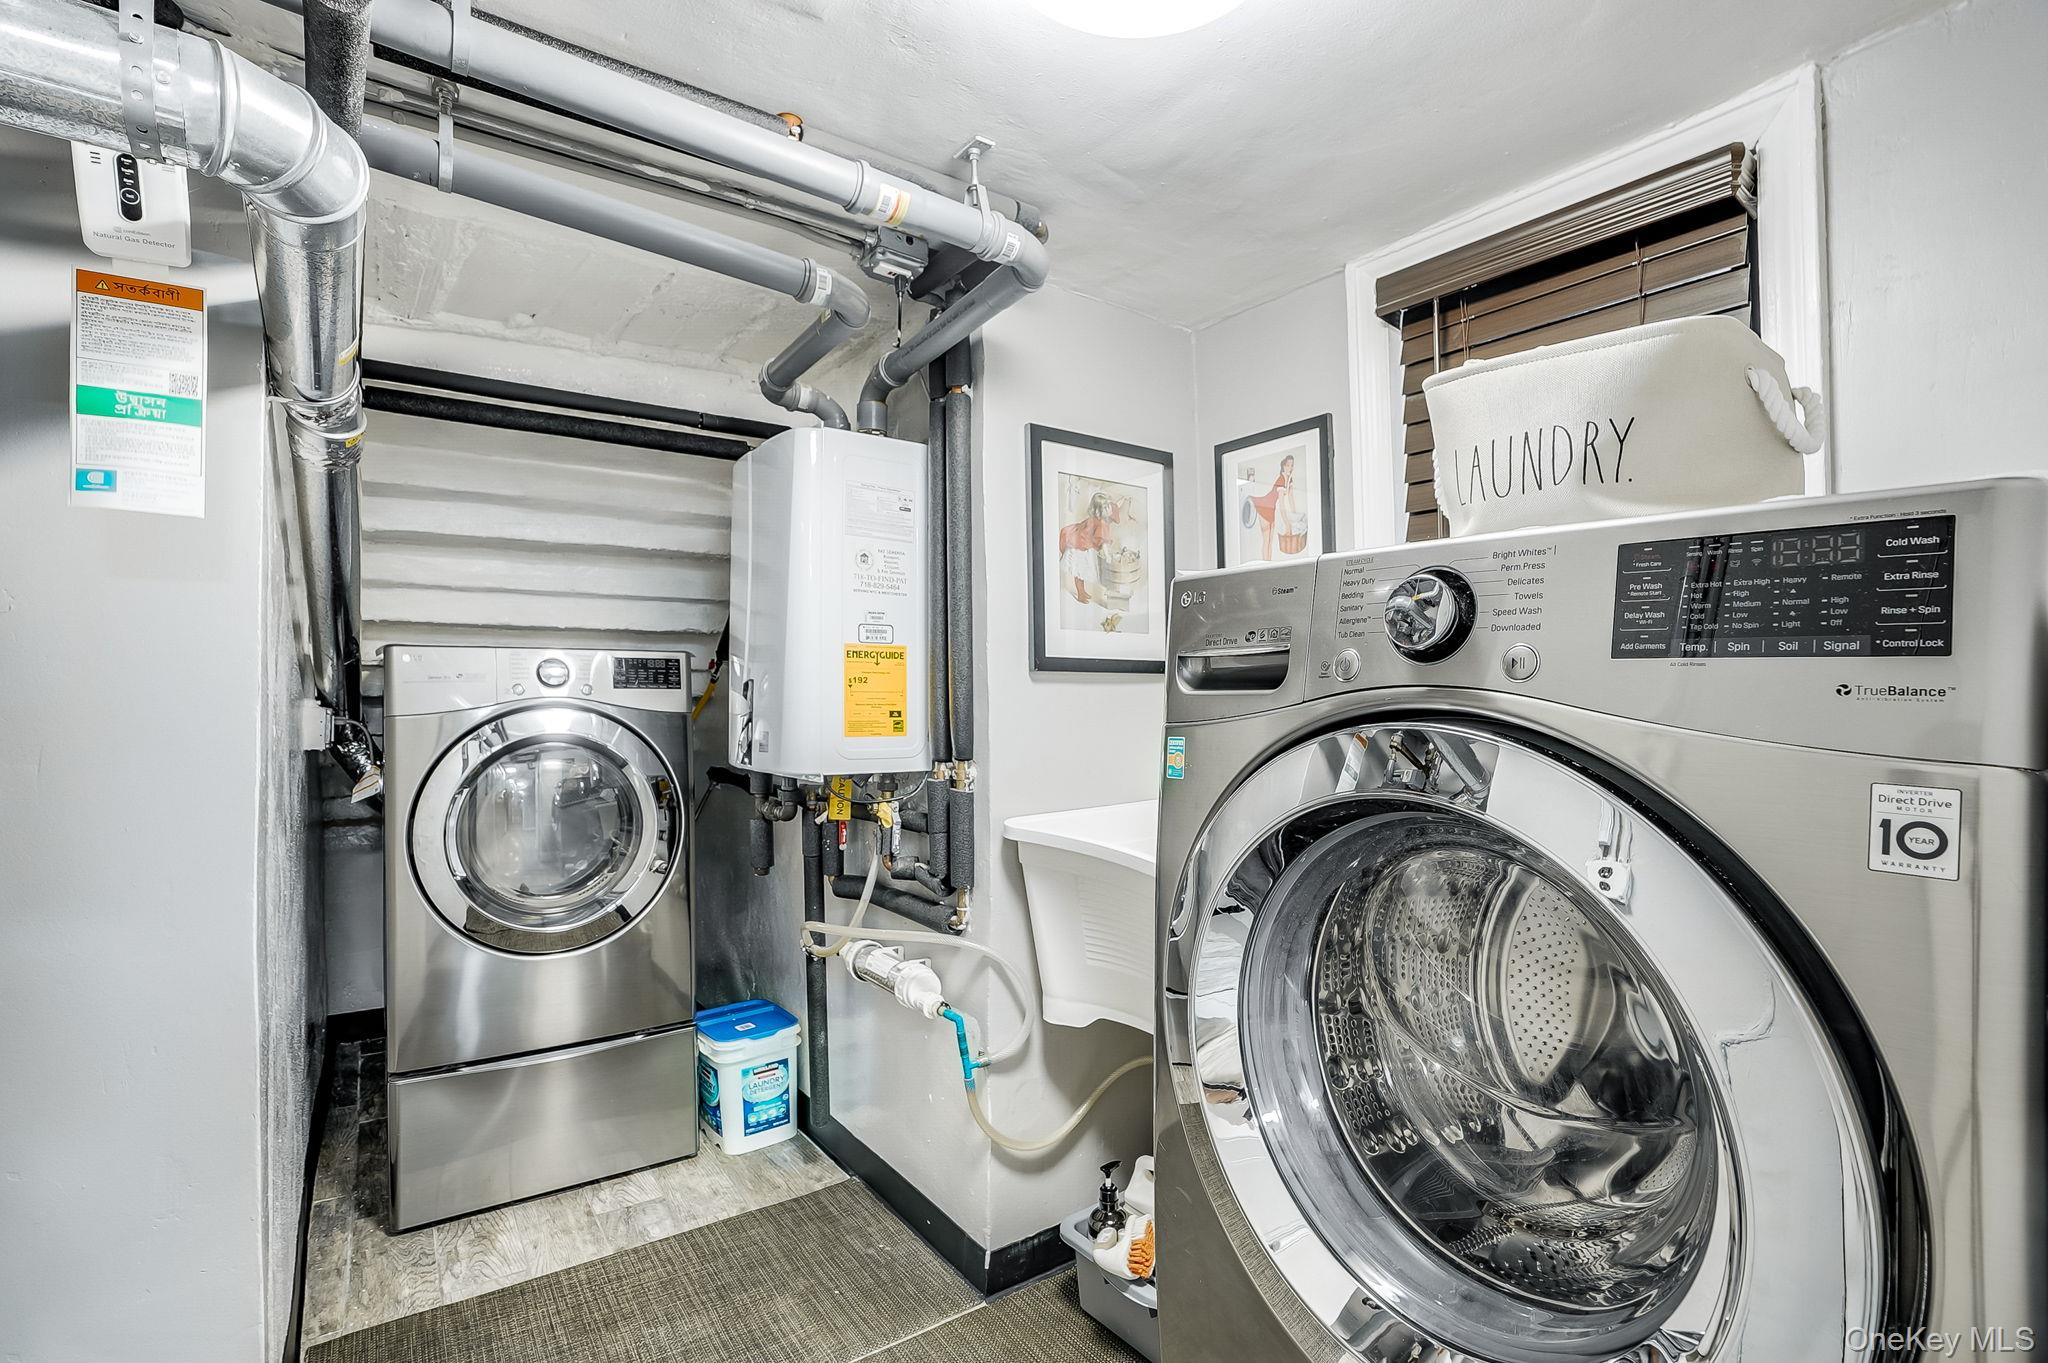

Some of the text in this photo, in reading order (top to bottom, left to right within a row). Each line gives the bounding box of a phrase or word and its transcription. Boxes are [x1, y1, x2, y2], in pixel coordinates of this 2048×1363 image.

[92, 231, 175, 249] Natural Gas Detector
[112, 281, 181, 301] সতর্কবাণী
[1885, 535, 1940, 547] Cold Wash
[1492, 550, 1517, 560] Bright
[1344, 566, 1365, 576] Normal
[1523, 562, 1546, 570] Press
[1782, 576, 1808, 584] Heavy
[1831, 573, 1862, 581] Remote
[1884, 571, 1940, 581] Extra Rinse
[1343, 577, 1376, 587] Heavy Duty
[1507, 577, 1545, 586] Delicates
[1642, 582, 1663, 590] Wash
[1341, 592, 1365, 600] Bedding
[1514, 592, 1544, 601] Towels
[1733, 590, 1750, 598] High
[1782, 598, 1810, 606] Normal
[1830, 596, 1850, 604] High
[1340, 605, 1364, 613] Sanitary
[1492, 606, 1543, 618] Speed Wash
[1881, 606, 1908, 615] Rinse
[1918, 605, 1941, 615] Spin
[1624, 611, 1665, 620] Delay Wash
[1490, 622, 1542, 632] Downloaded
[1743, 622, 1760, 630] Spin
[1781, 621, 1801, 629] Light
[1338, 631, 1349, 639] Tub
[1205, 637, 1238, 647] Direct Drive
[1778, 641, 1799, 651] Soil
[1823, 640, 1860, 652] Signal
[1882, 639, 1944, 647] Control Lock
[1680, 642, 1709, 653] Temp.
[1727, 642, 1750, 653] Spin
[846, 649, 905, 661] ENERGYGUIDE
[848, 676, 869, 685] $192
[1897, 789, 1934, 797] INVERTER
[1878, 794, 1953, 809] Direct Drive
[1879, 818, 1949, 861] 10
[1908, 836, 1935, 846] YEAR
[1881, 860, 1946, 873] WARRANTY
[748, 1075, 786, 1091] LAUNDRY
